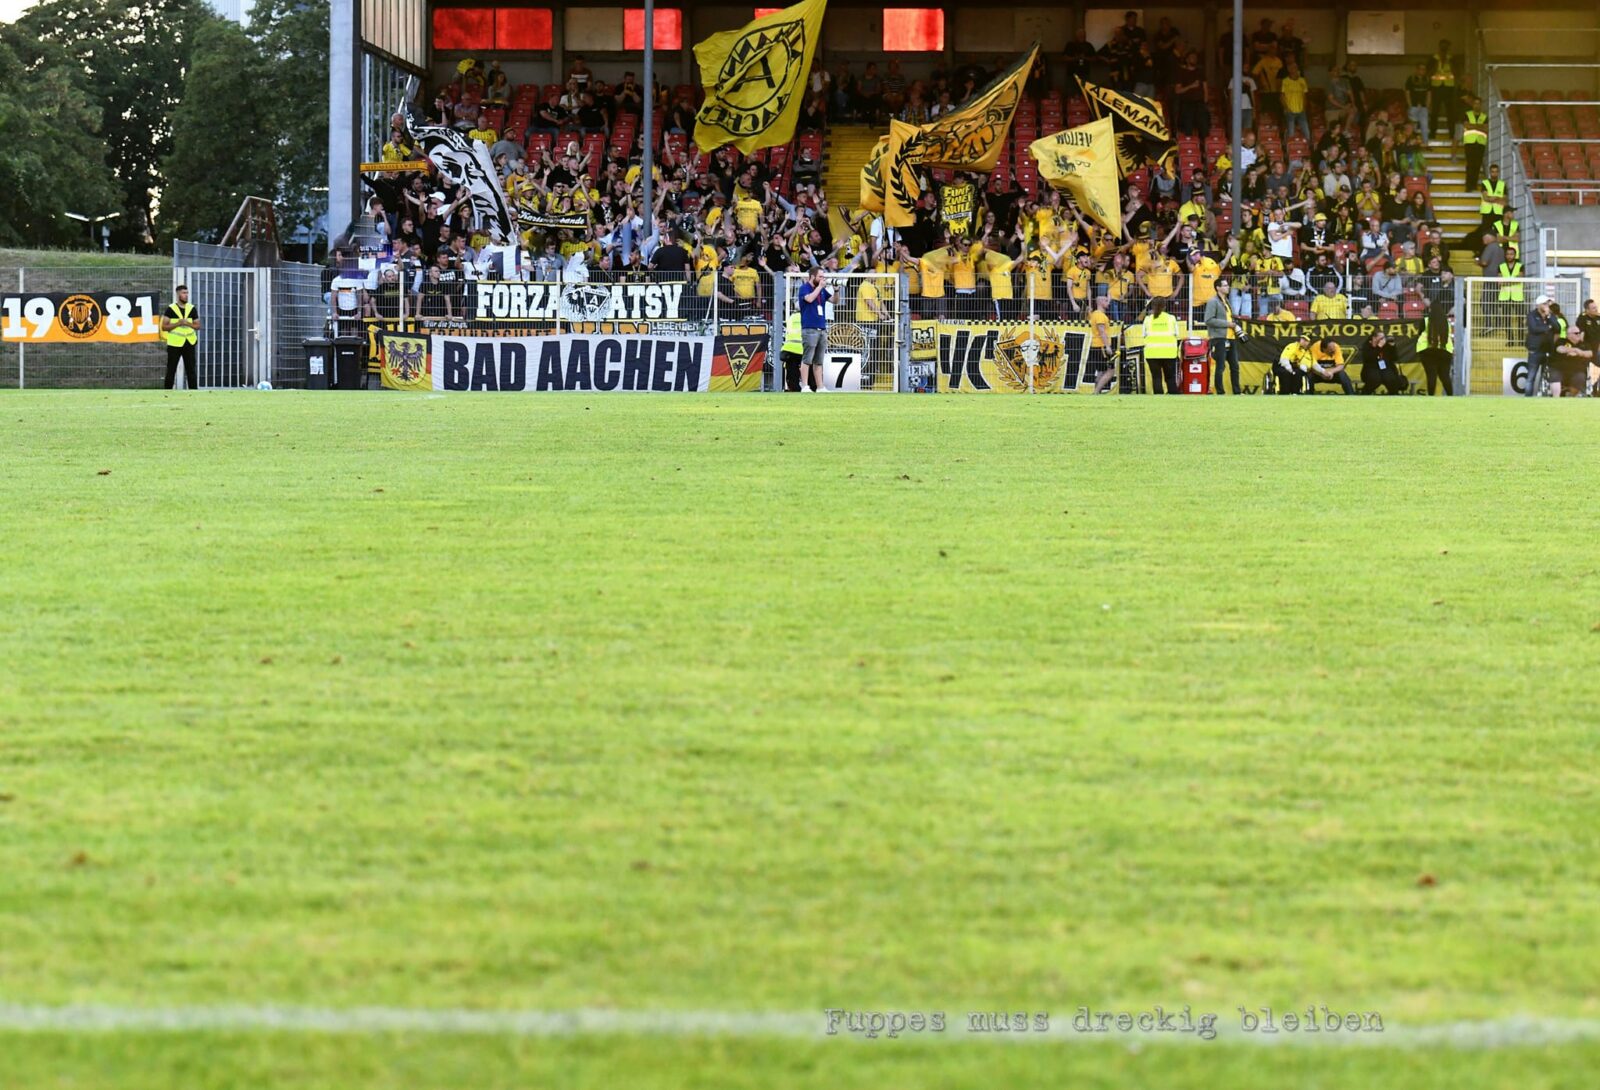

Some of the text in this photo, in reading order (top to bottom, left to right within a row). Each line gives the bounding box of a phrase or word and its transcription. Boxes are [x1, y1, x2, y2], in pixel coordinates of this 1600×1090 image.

[2, 296, 159, 338] 19 81
[476, 284, 683, 319] FORZA ATSV
[443, 339, 704, 392] BAD AACHEN
[831, 357, 853, 388] 7
[1510, 361, 1529, 394] 6
